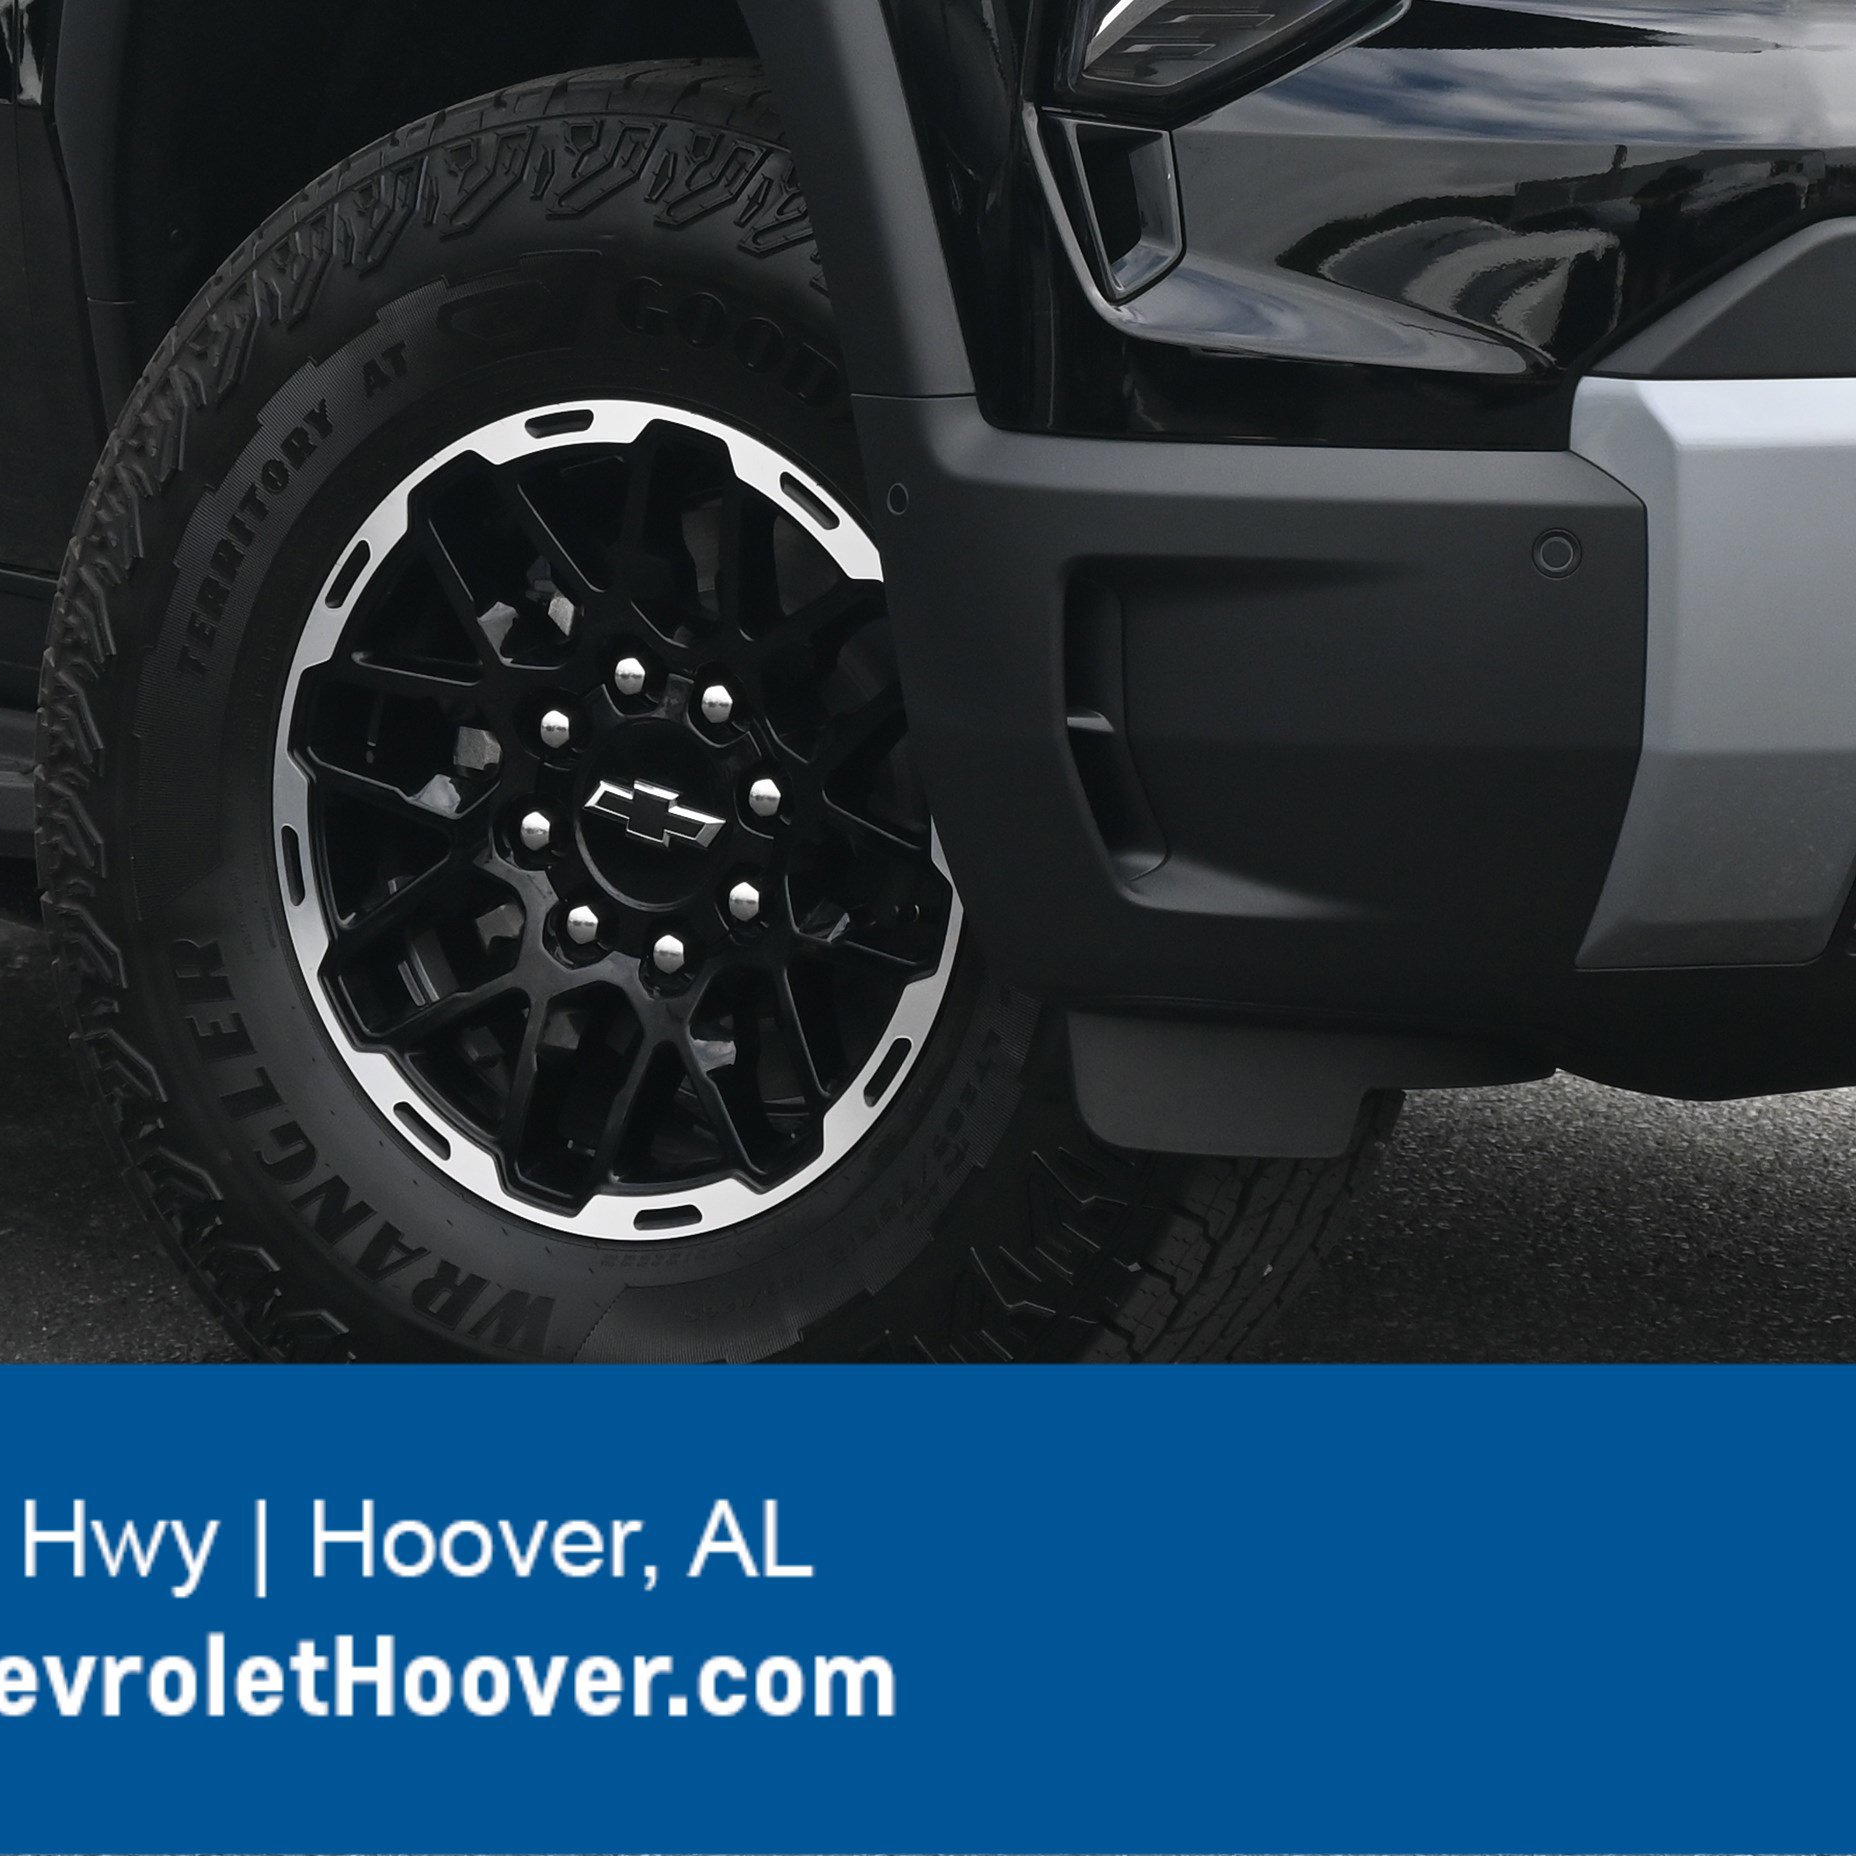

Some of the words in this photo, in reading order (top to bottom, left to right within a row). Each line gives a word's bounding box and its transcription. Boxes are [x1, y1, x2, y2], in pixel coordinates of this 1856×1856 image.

[176, 397, 334, 679] TERRITORY
[360, 341, 409, 400] AT
[171, 937, 558, 1357] WRANGLER
